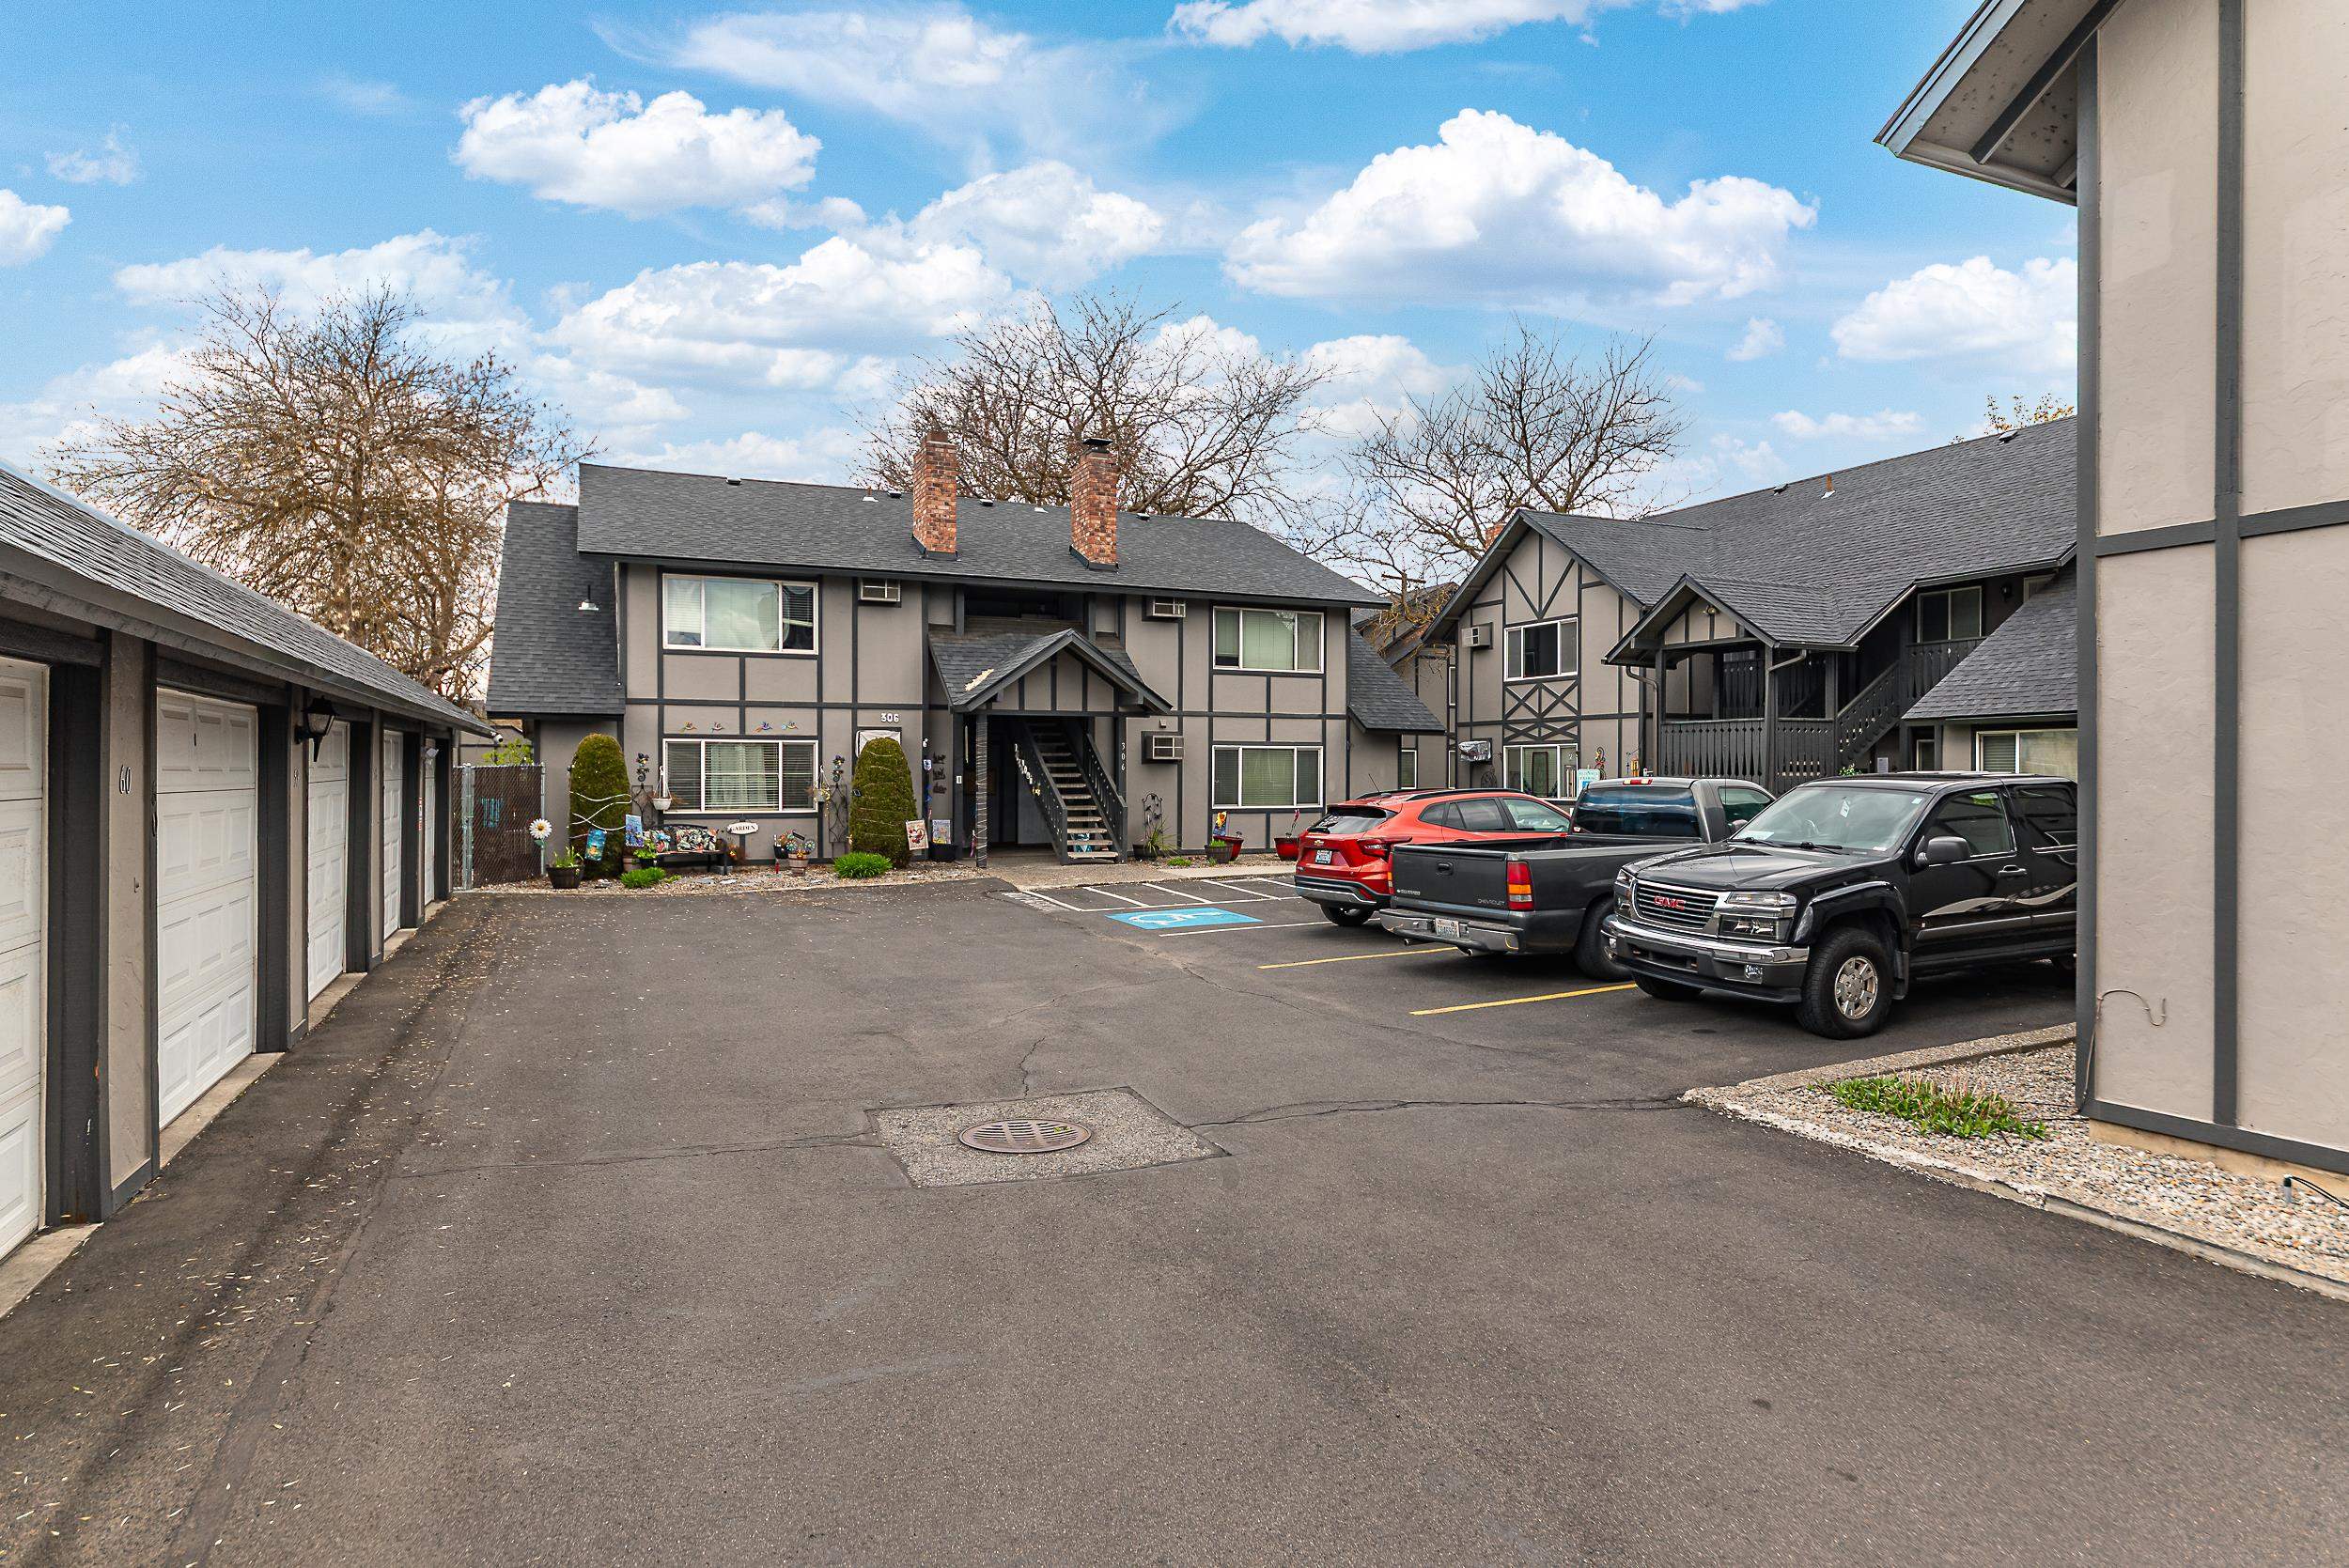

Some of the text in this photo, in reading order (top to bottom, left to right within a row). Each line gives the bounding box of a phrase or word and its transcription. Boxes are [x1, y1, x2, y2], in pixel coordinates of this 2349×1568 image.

[880, 712, 899, 722] 306
[119, 764, 132, 795] 60
[1654, 895, 1685, 909] GMC
